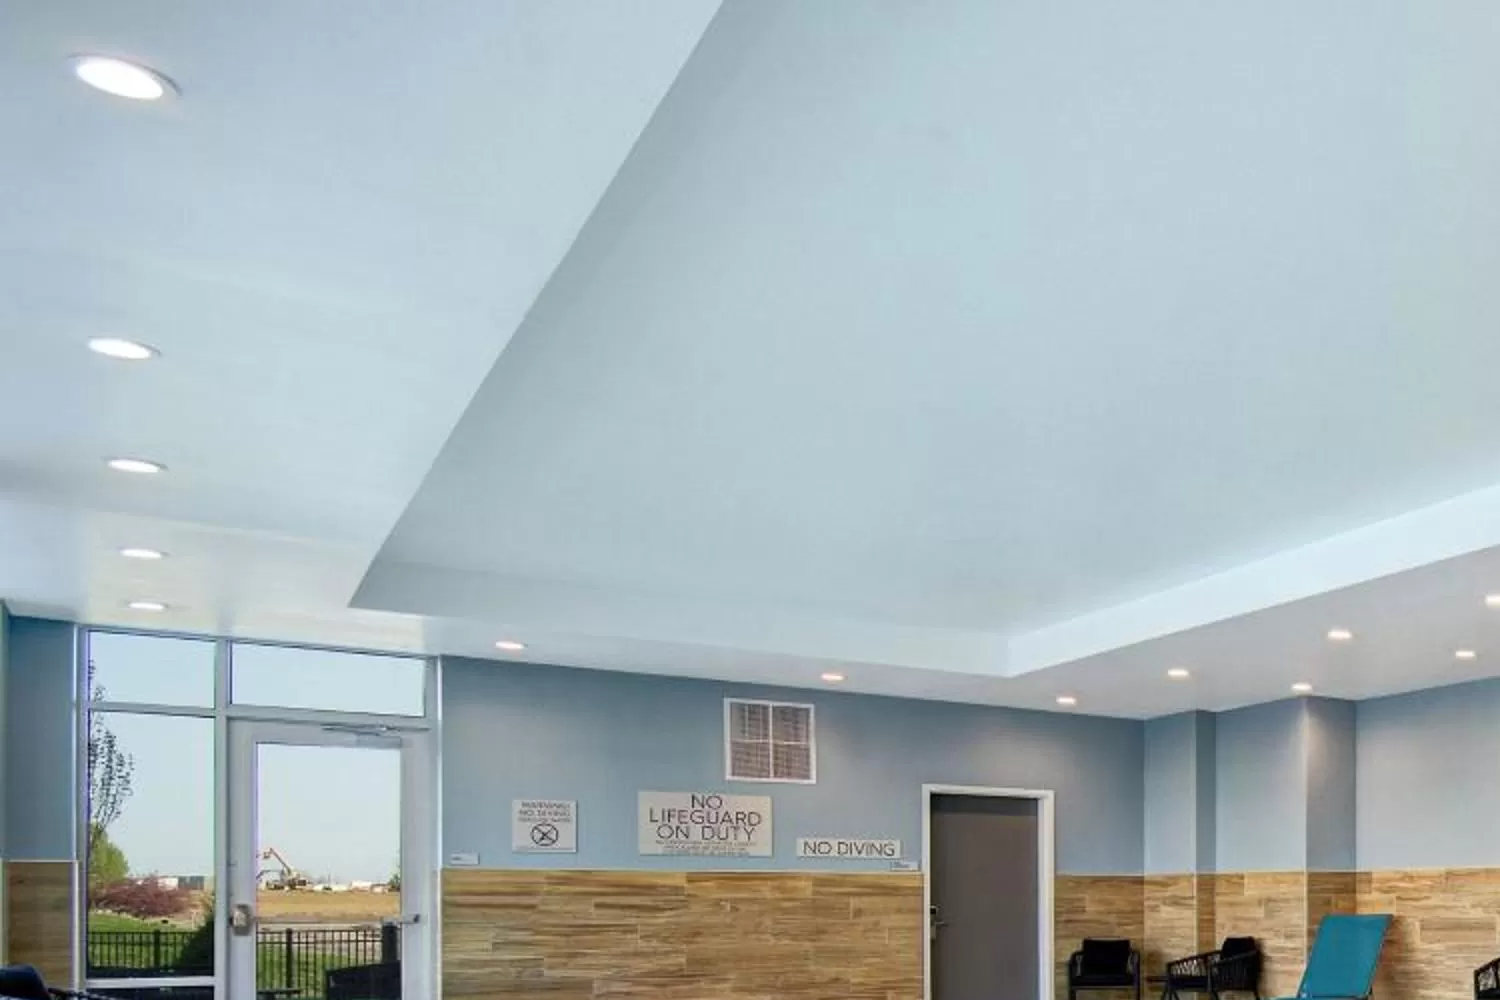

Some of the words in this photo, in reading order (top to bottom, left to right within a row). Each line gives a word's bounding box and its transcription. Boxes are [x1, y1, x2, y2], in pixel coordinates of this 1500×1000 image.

[691, 793, 723, 810] NO
[649, 807, 762, 826] LIFEGUARD
[656, 824, 690, 839] ON
[701, 825, 755, 841] DUTY
[803, 841, 833, 856] NO
[837, 841, 895, 856] DIVING
